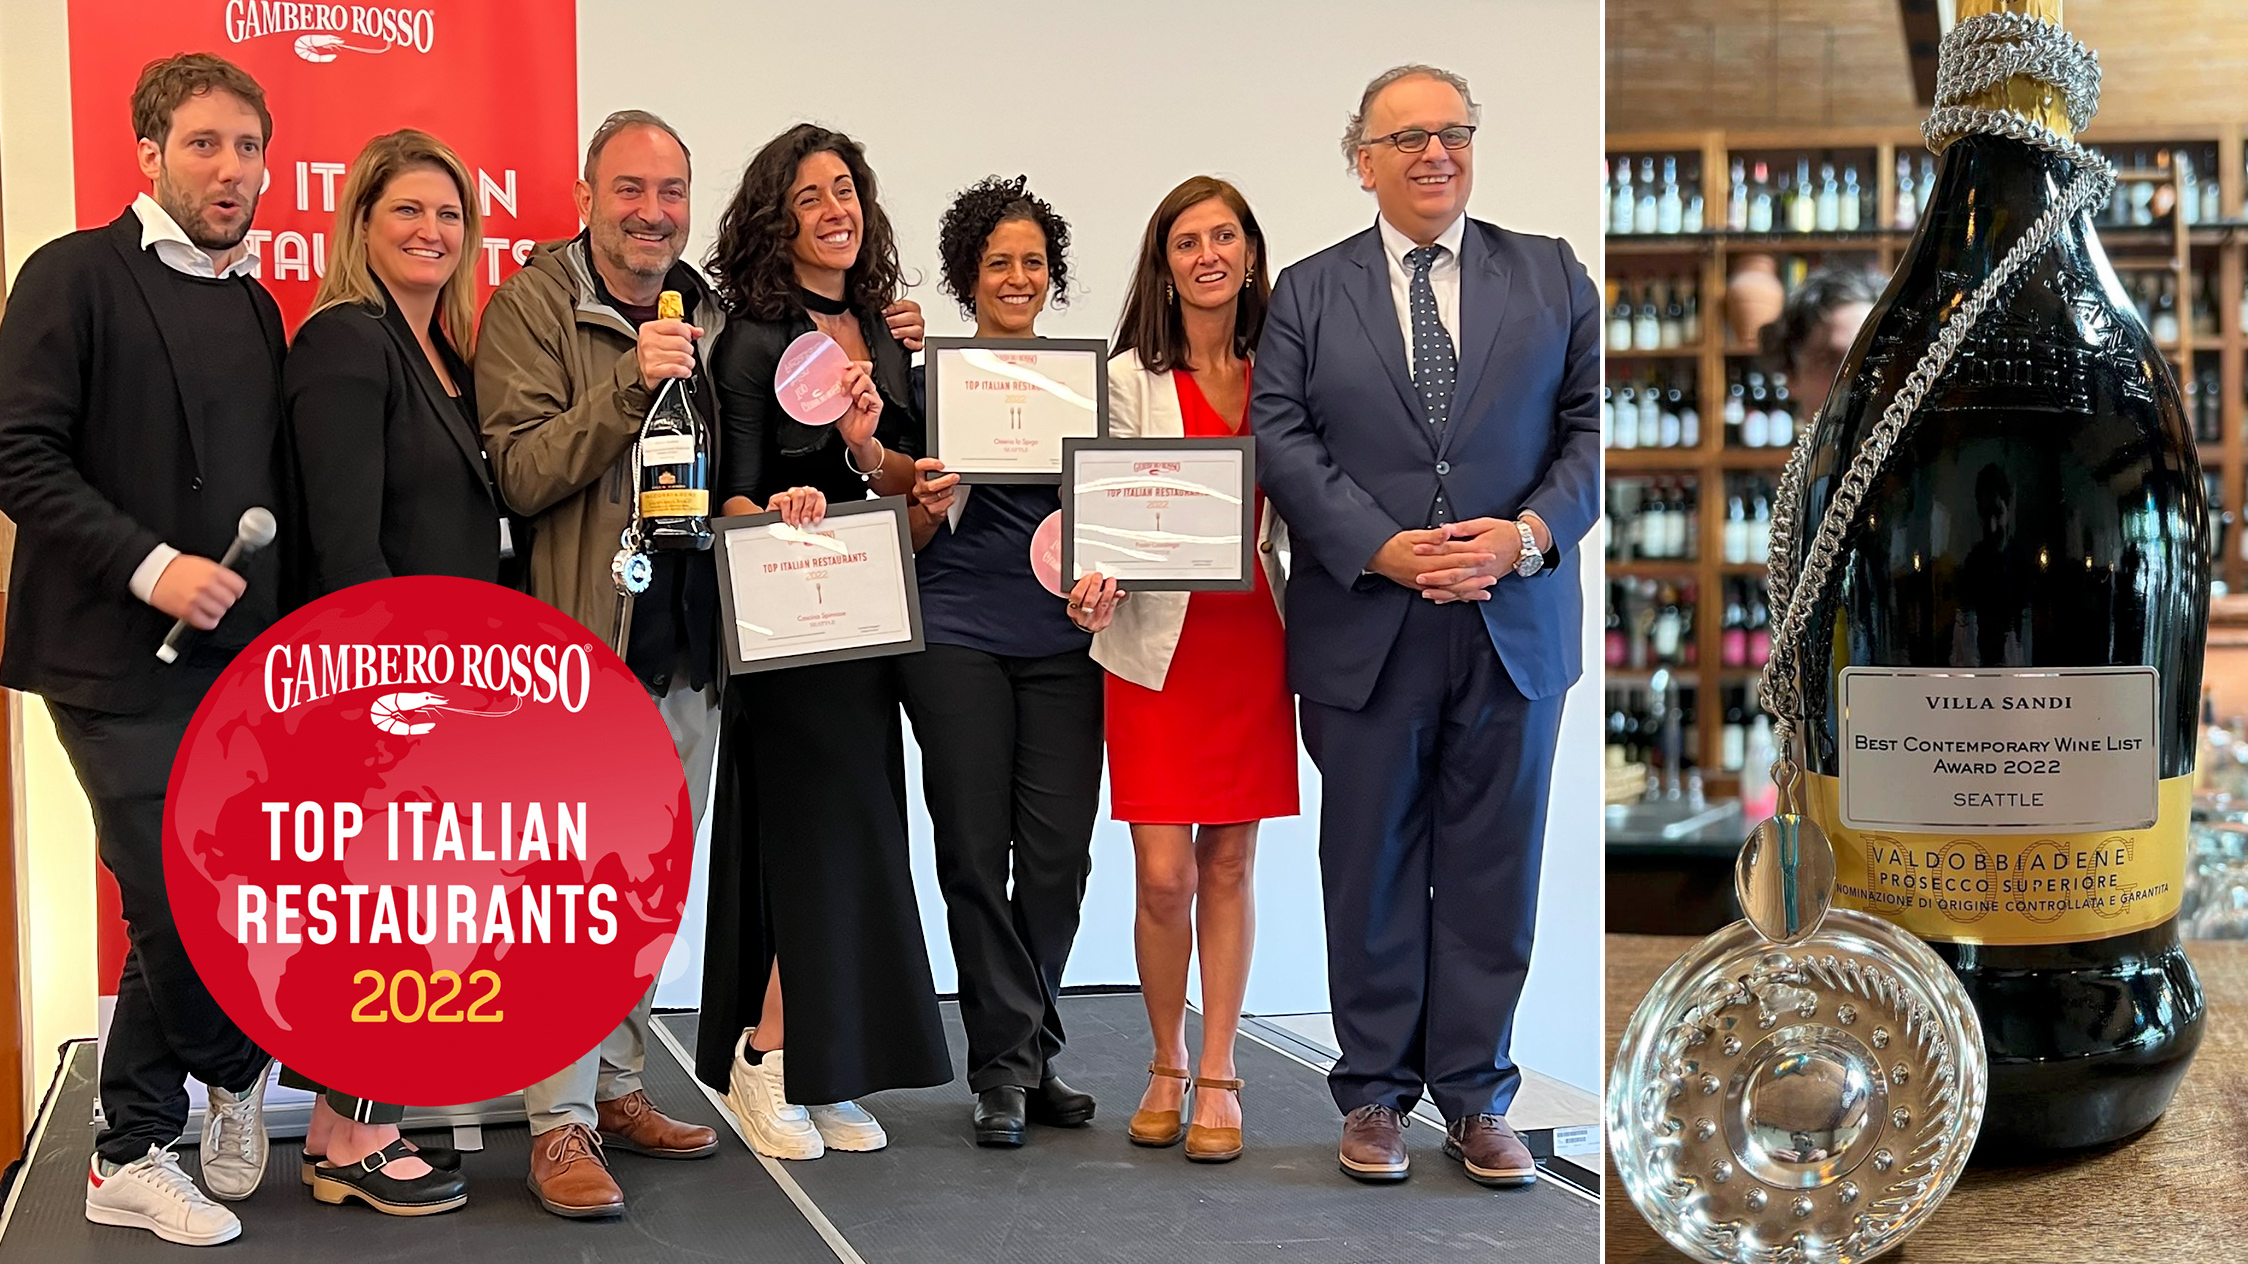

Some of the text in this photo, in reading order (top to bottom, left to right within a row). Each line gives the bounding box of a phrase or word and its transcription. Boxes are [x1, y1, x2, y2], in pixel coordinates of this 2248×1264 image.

[225, 0, 348, 43] GAMBERO
[763, 552, 868, 574] TOP ITALIAN RESTAURANTS
[1925, 696, 2072, 710] VILLA SANDI
[2004, 760, 2061, 774] 2022
[1953, 793, 2044, 807] SEATTLE
[1872, 847, 2125, 871] VALDOBBIADENE
[1880, 872, 2117, 893] PROSECCO SUPERIORE
[1836, 883, 2169, 912] NOMINAZIONE DI ORIGINE CONTROLLATA E GARANTITA
